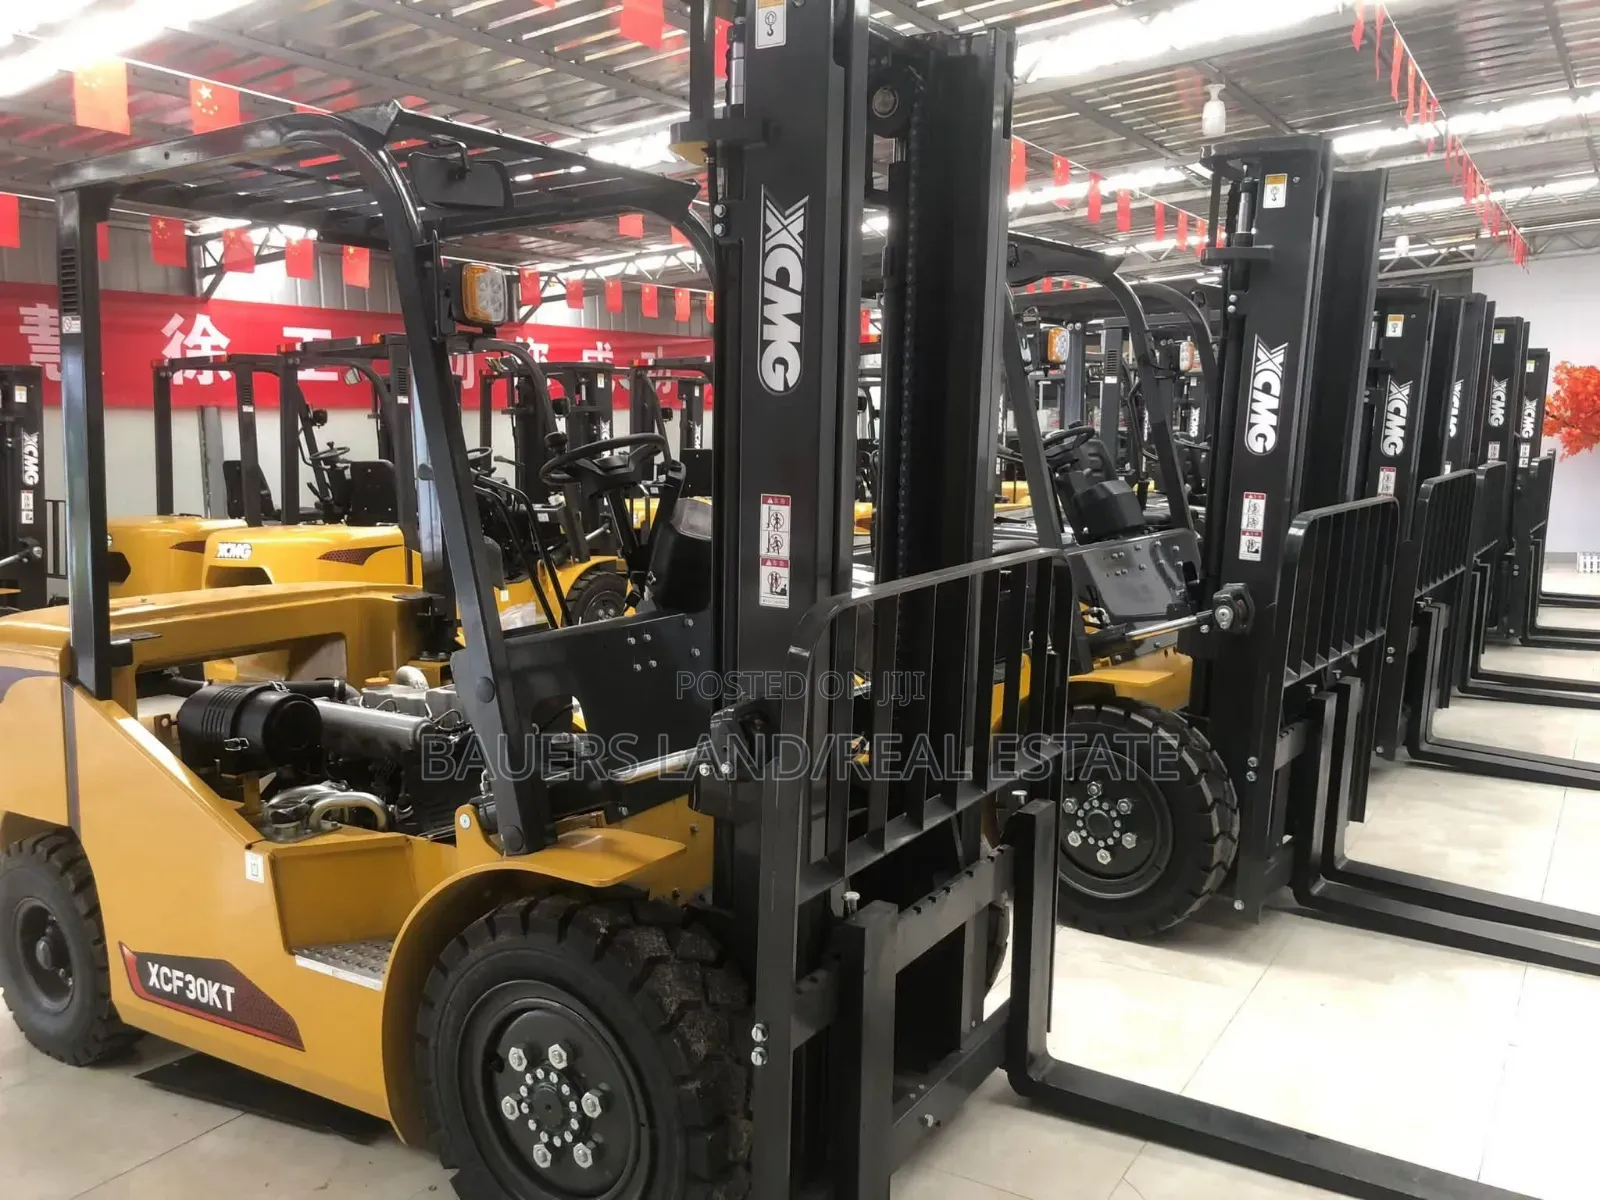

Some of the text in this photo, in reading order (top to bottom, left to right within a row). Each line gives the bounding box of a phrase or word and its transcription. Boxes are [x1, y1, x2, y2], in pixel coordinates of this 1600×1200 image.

[757, 184, 809, 396] XCMG
[1244, 333, 1289, 456] XCMG
[1380, 374, 1413, 457] XCMG
[1489, 375, 1508, 427] XCMG
[1520, 396, 1538, 439] XCMG
[21, 428, 40, 486] XCMG
[147, 961, 235, 1012] XCF30KT
